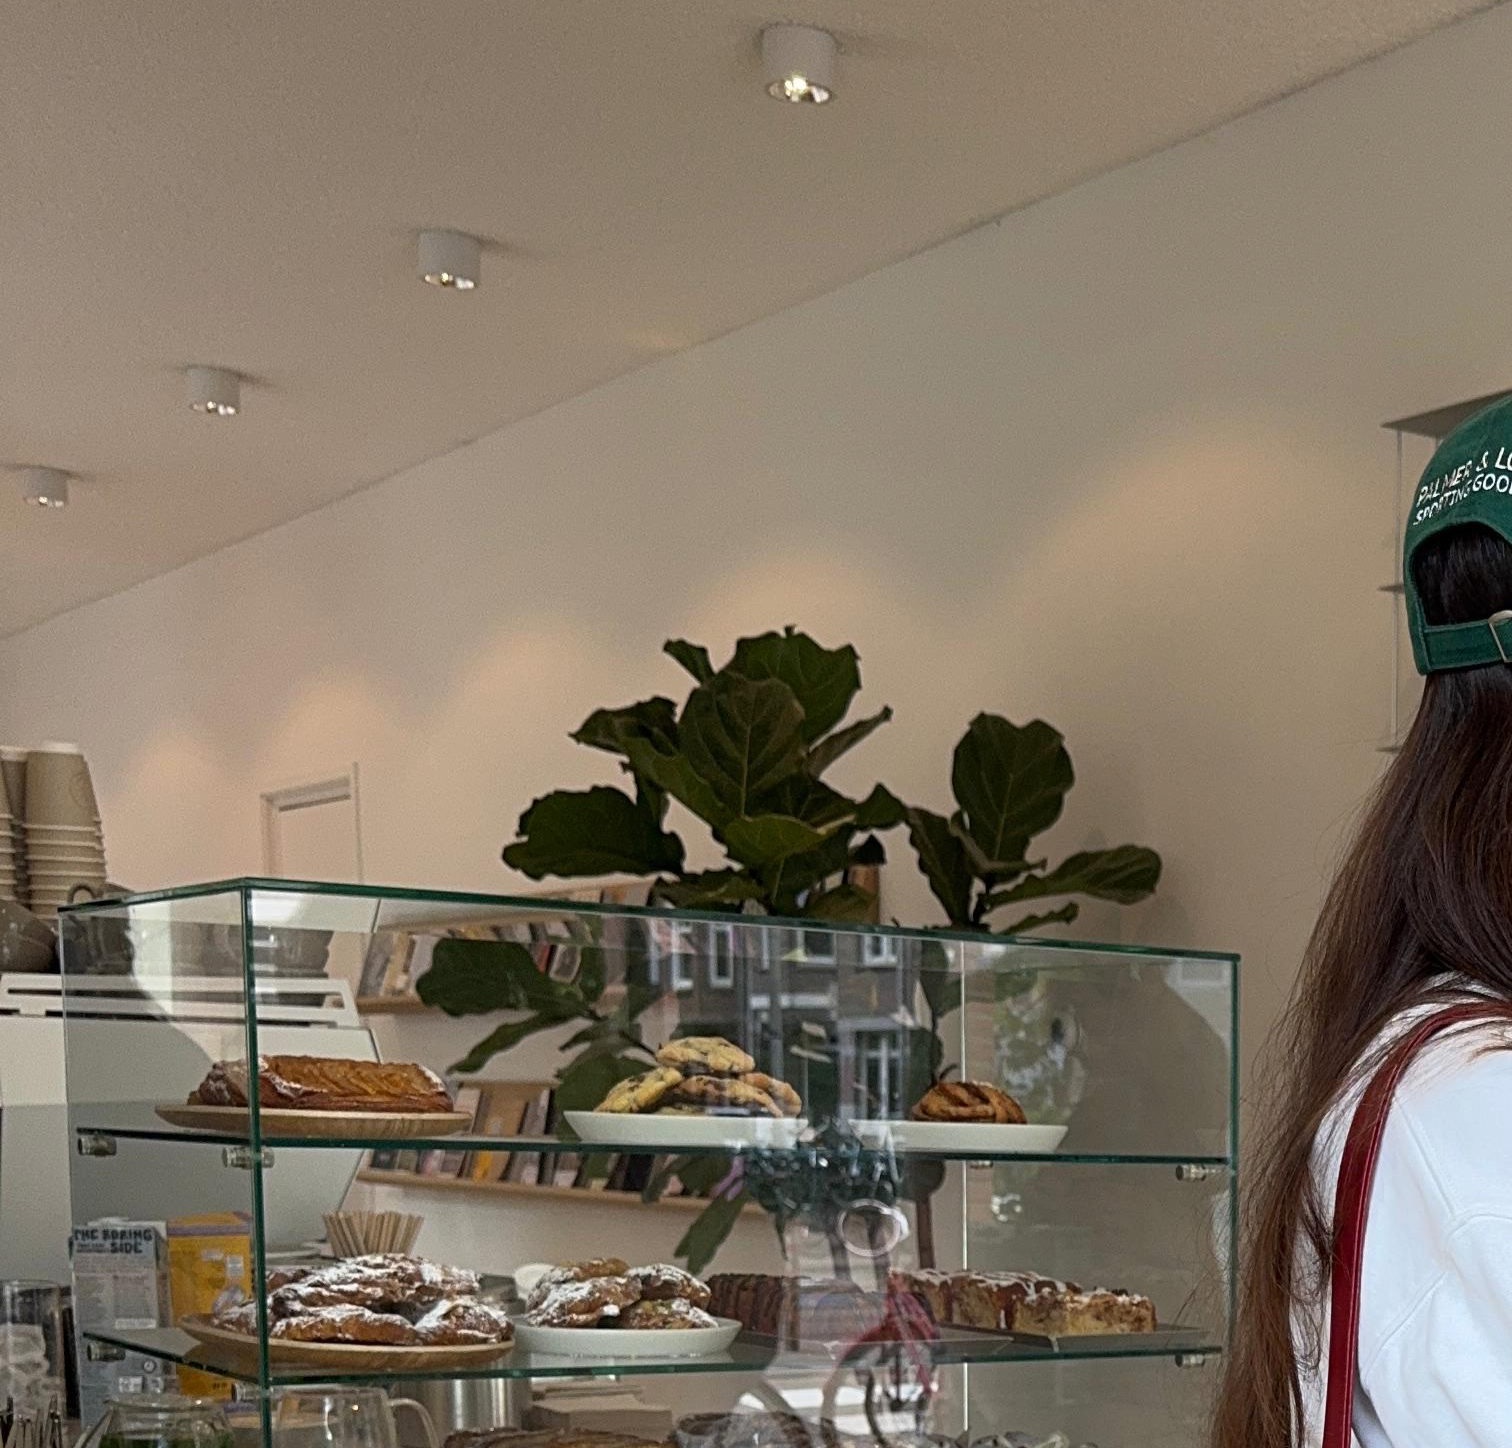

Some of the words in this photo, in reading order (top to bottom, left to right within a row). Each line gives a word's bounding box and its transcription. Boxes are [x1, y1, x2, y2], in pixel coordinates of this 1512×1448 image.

[1412, 479, 1472, 526] SPORTING
[1416, 460, 1472, 507] PALMER
[1476, 451, 1489, 472] &
[110, 1242, 142, 1254] SIDE
